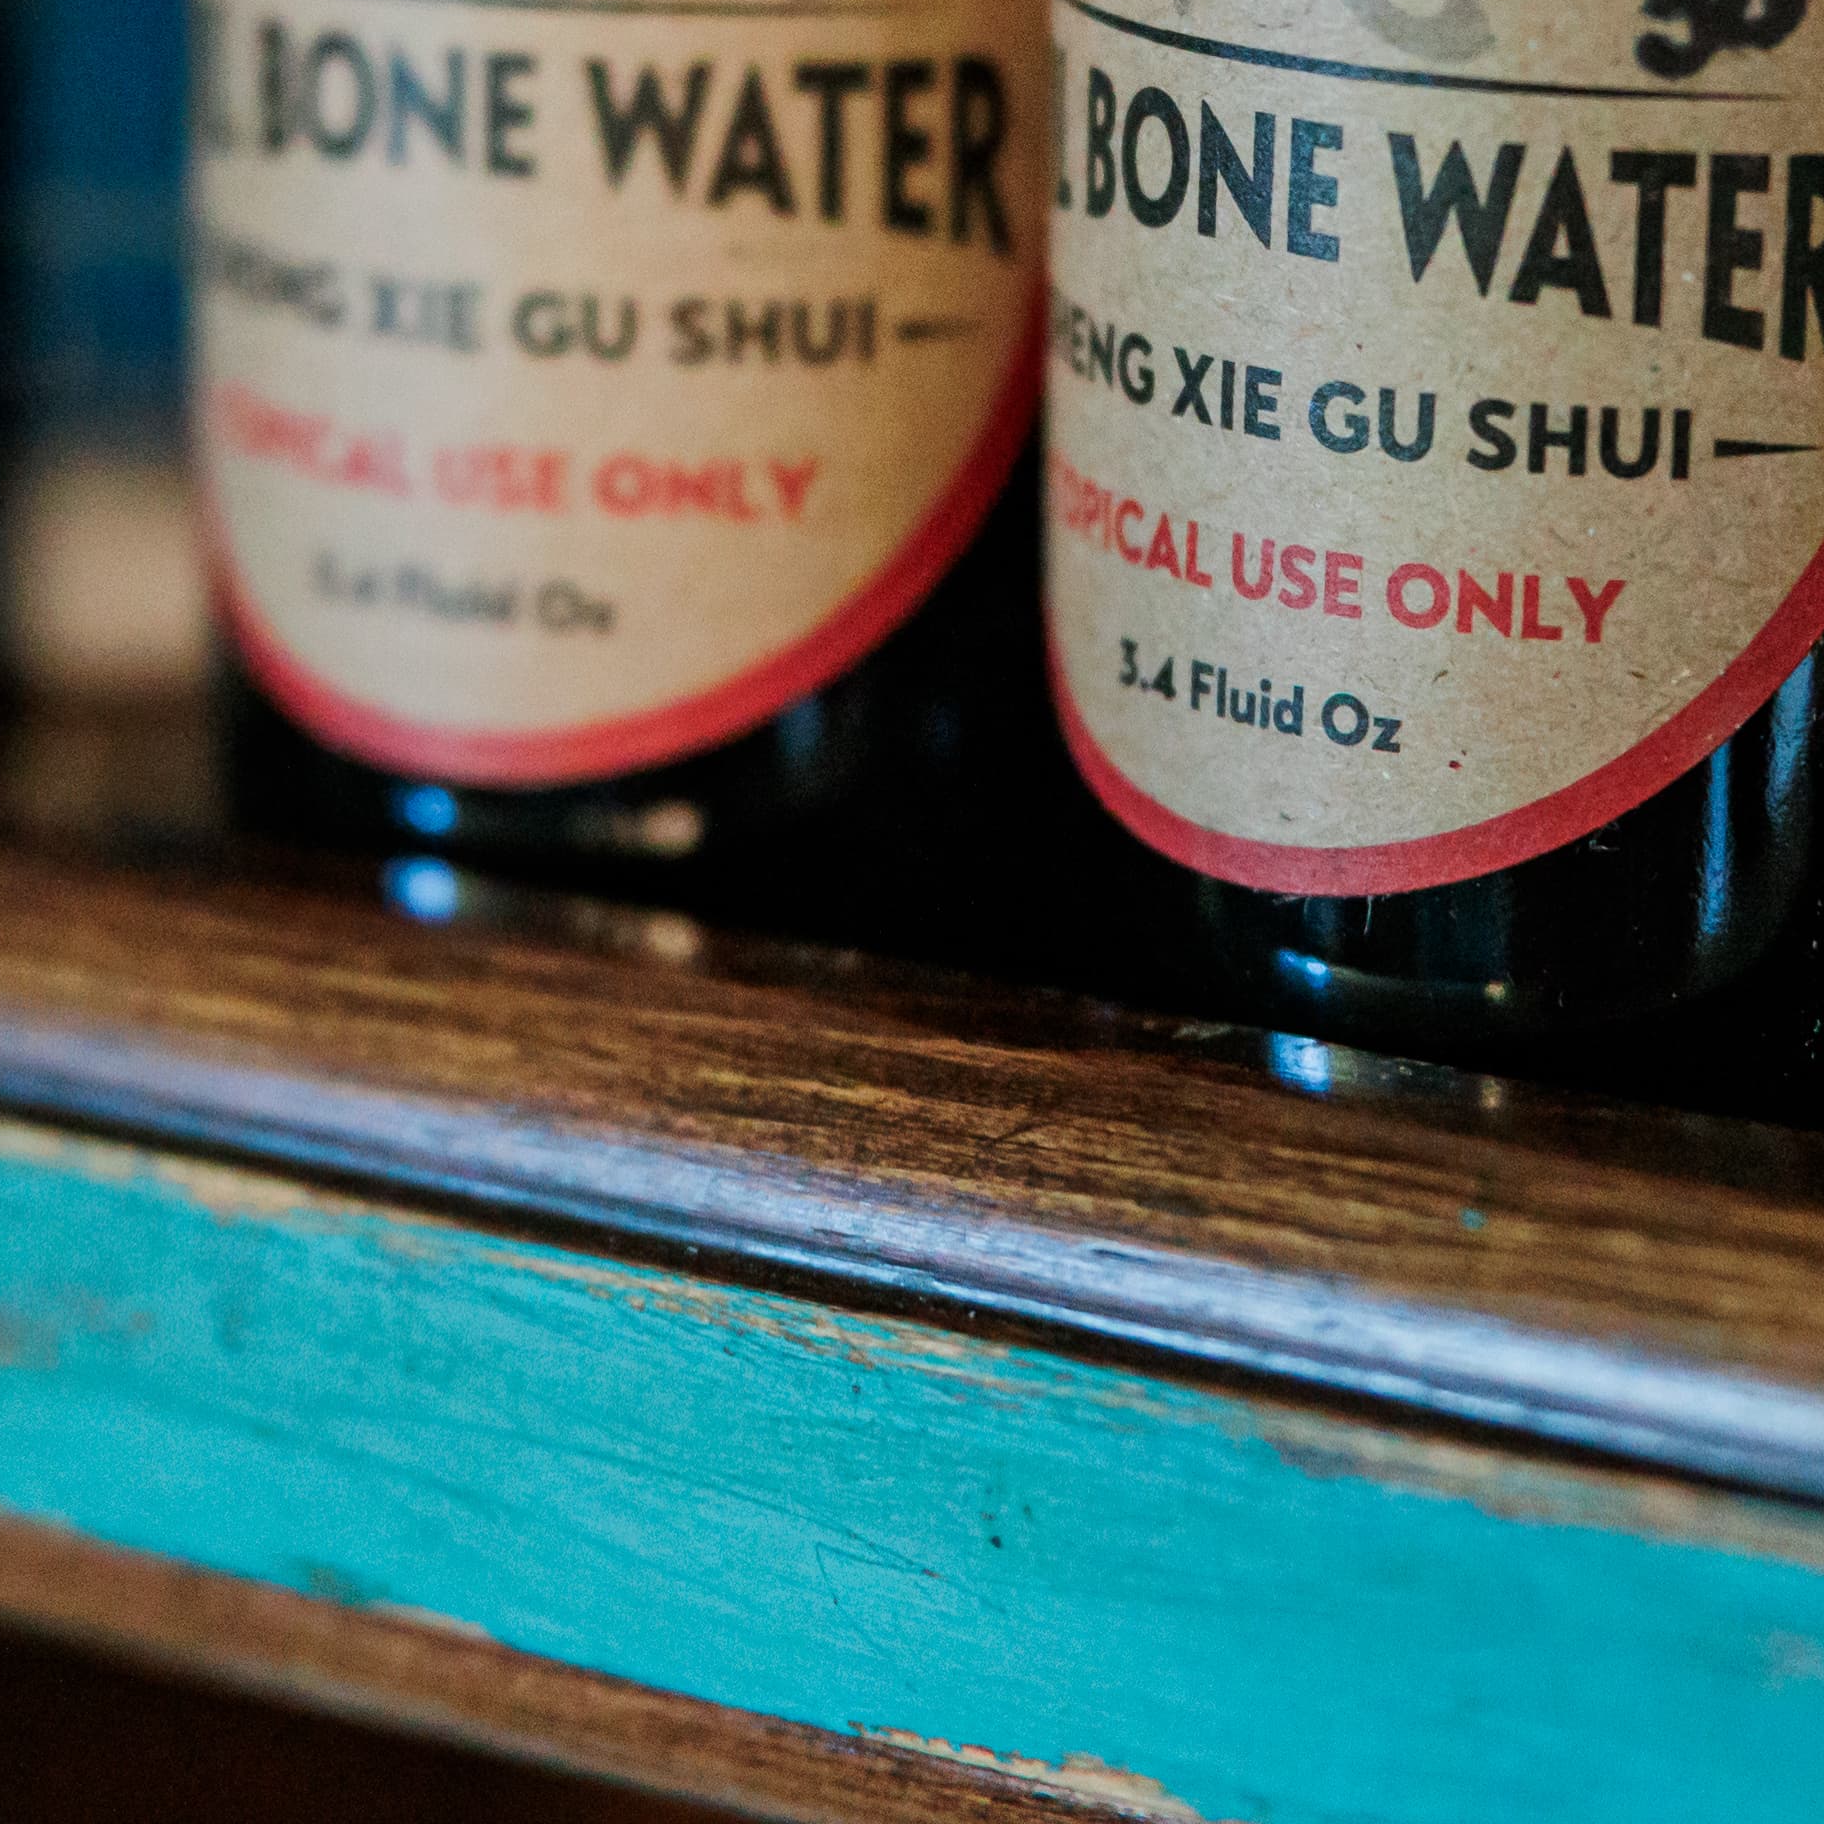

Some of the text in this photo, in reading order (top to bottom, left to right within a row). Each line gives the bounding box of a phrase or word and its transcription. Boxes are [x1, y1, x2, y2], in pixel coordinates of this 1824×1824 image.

[587, 51, 1016, 256] WATER
[1086, 66, 1344, 263] BONE
[512, 289, 639, 364] GU
[1172, 346, 1283, 442] XIE
[1307, 379, 1436, 463] GU
[592, 449, 826, 527] ONLY
[1230, 532, 1364, 619] USE
[1386, 562, 1627, 644] ONLY
[1119, 637, 1403, 754] 3.4 Fluid Oz
